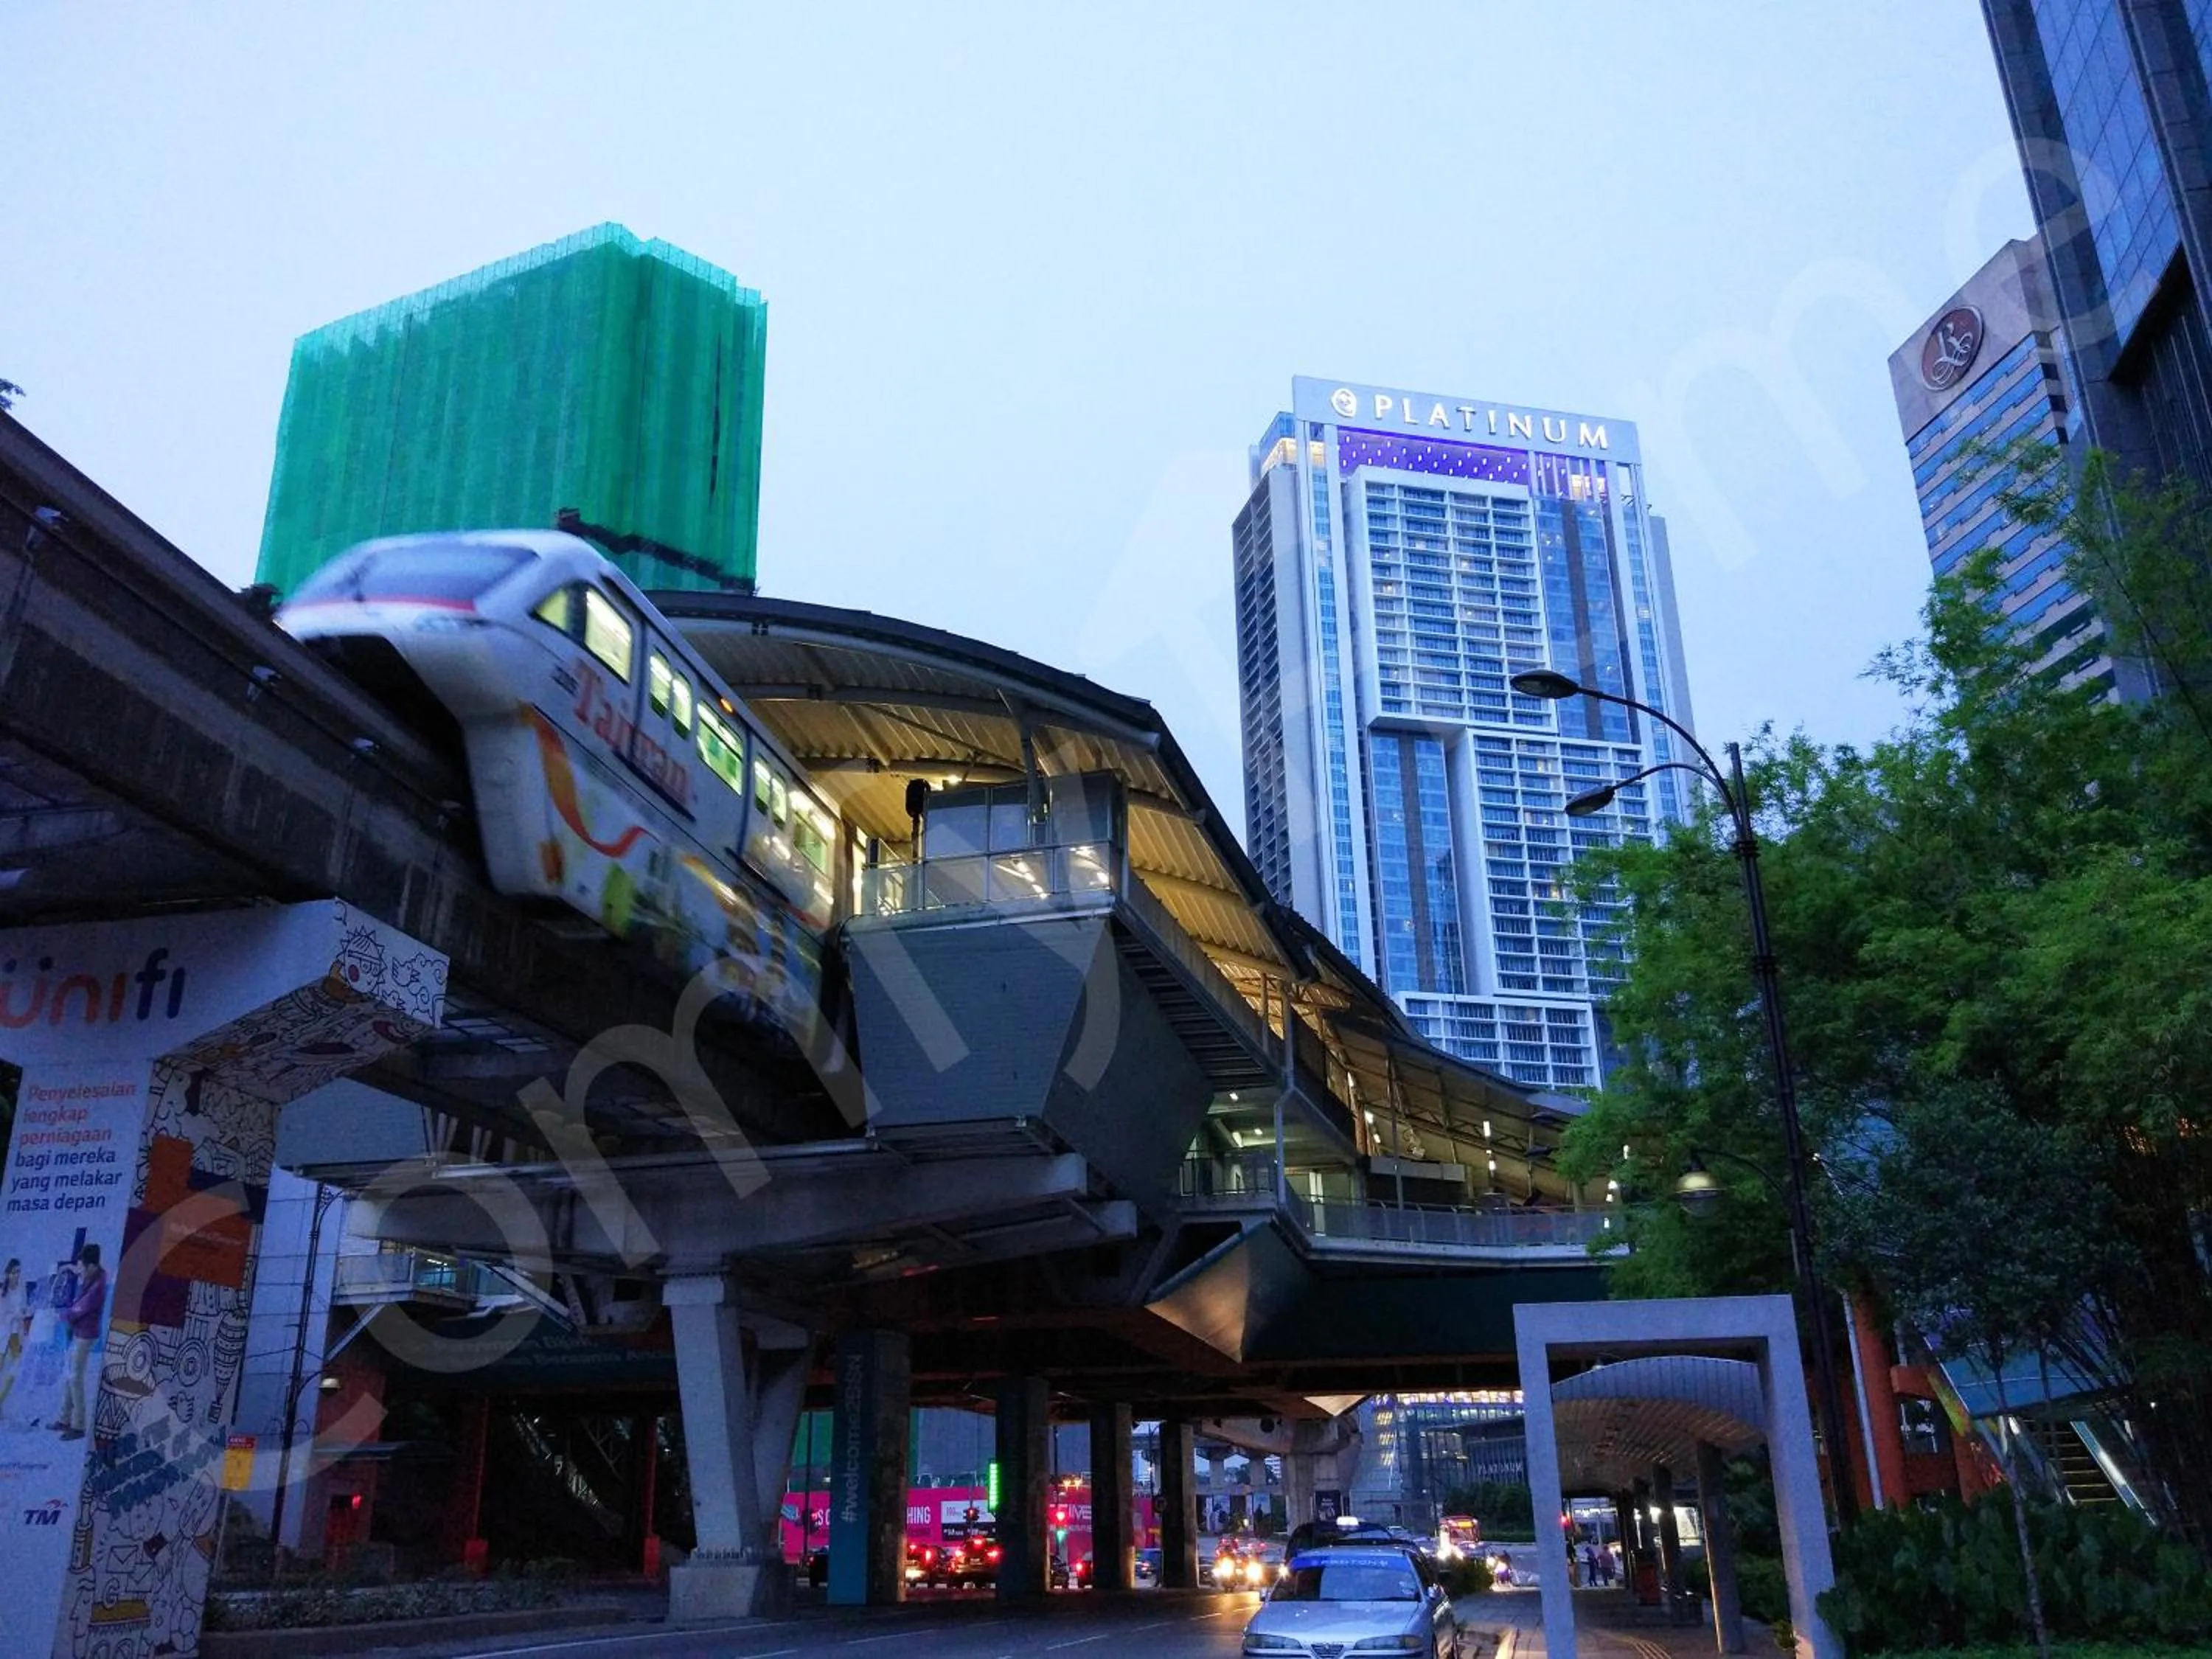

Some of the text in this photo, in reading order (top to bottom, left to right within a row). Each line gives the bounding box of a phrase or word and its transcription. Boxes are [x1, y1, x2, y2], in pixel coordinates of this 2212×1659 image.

[1374, 394, 1608, 449] PLATINUM
[28, 1081, 136, 1103] Penyelesaian
[23, 1106, 88, 1125] lengkap
[20, 1128, 111, 1149] perniagaan
[15, 1147, 116, 1170] bagi mereka
[11, 1171, 122, 1194] yang melakar
[7, 1194, 105, 1212] masa depan
[24, 1509, 62, 1526] TM
